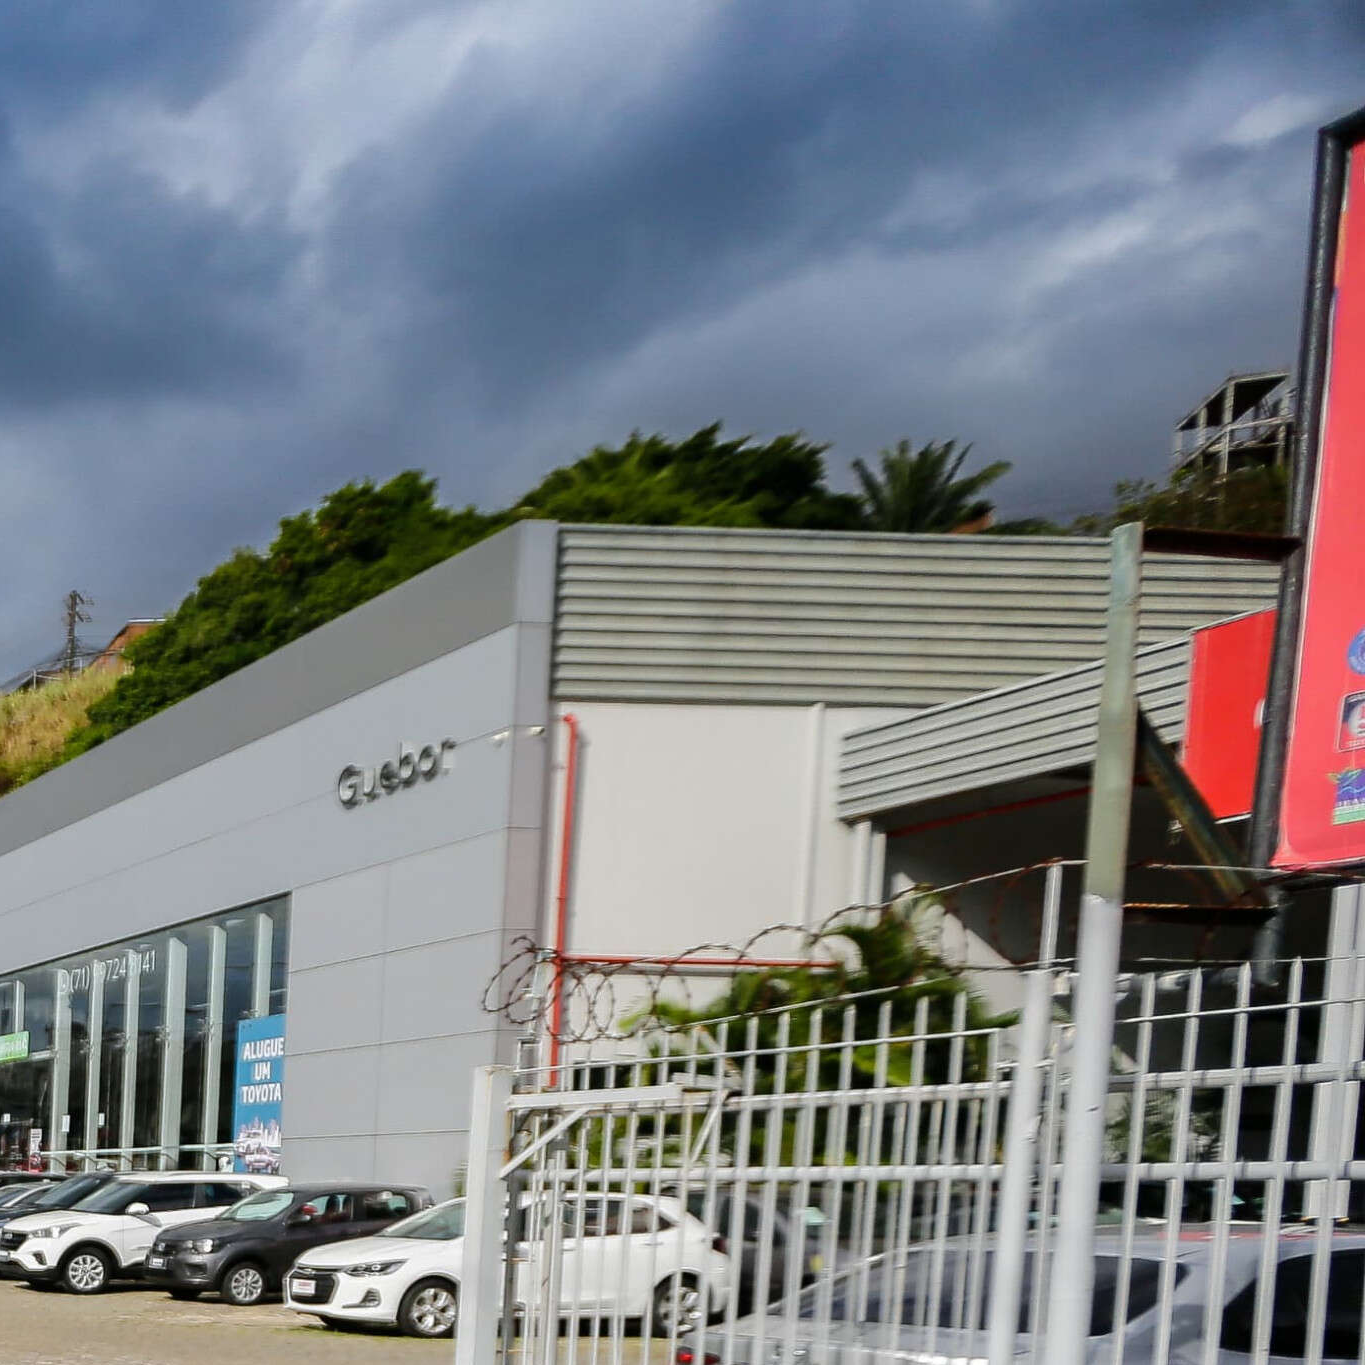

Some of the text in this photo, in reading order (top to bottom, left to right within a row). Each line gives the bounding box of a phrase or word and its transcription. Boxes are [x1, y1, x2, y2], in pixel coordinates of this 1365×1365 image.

[242, 1036, 285, 1062] ALUGUE
[254, 1060, 271, 1081] UM
[241, 1082, 282, 1104] TOYOTA
